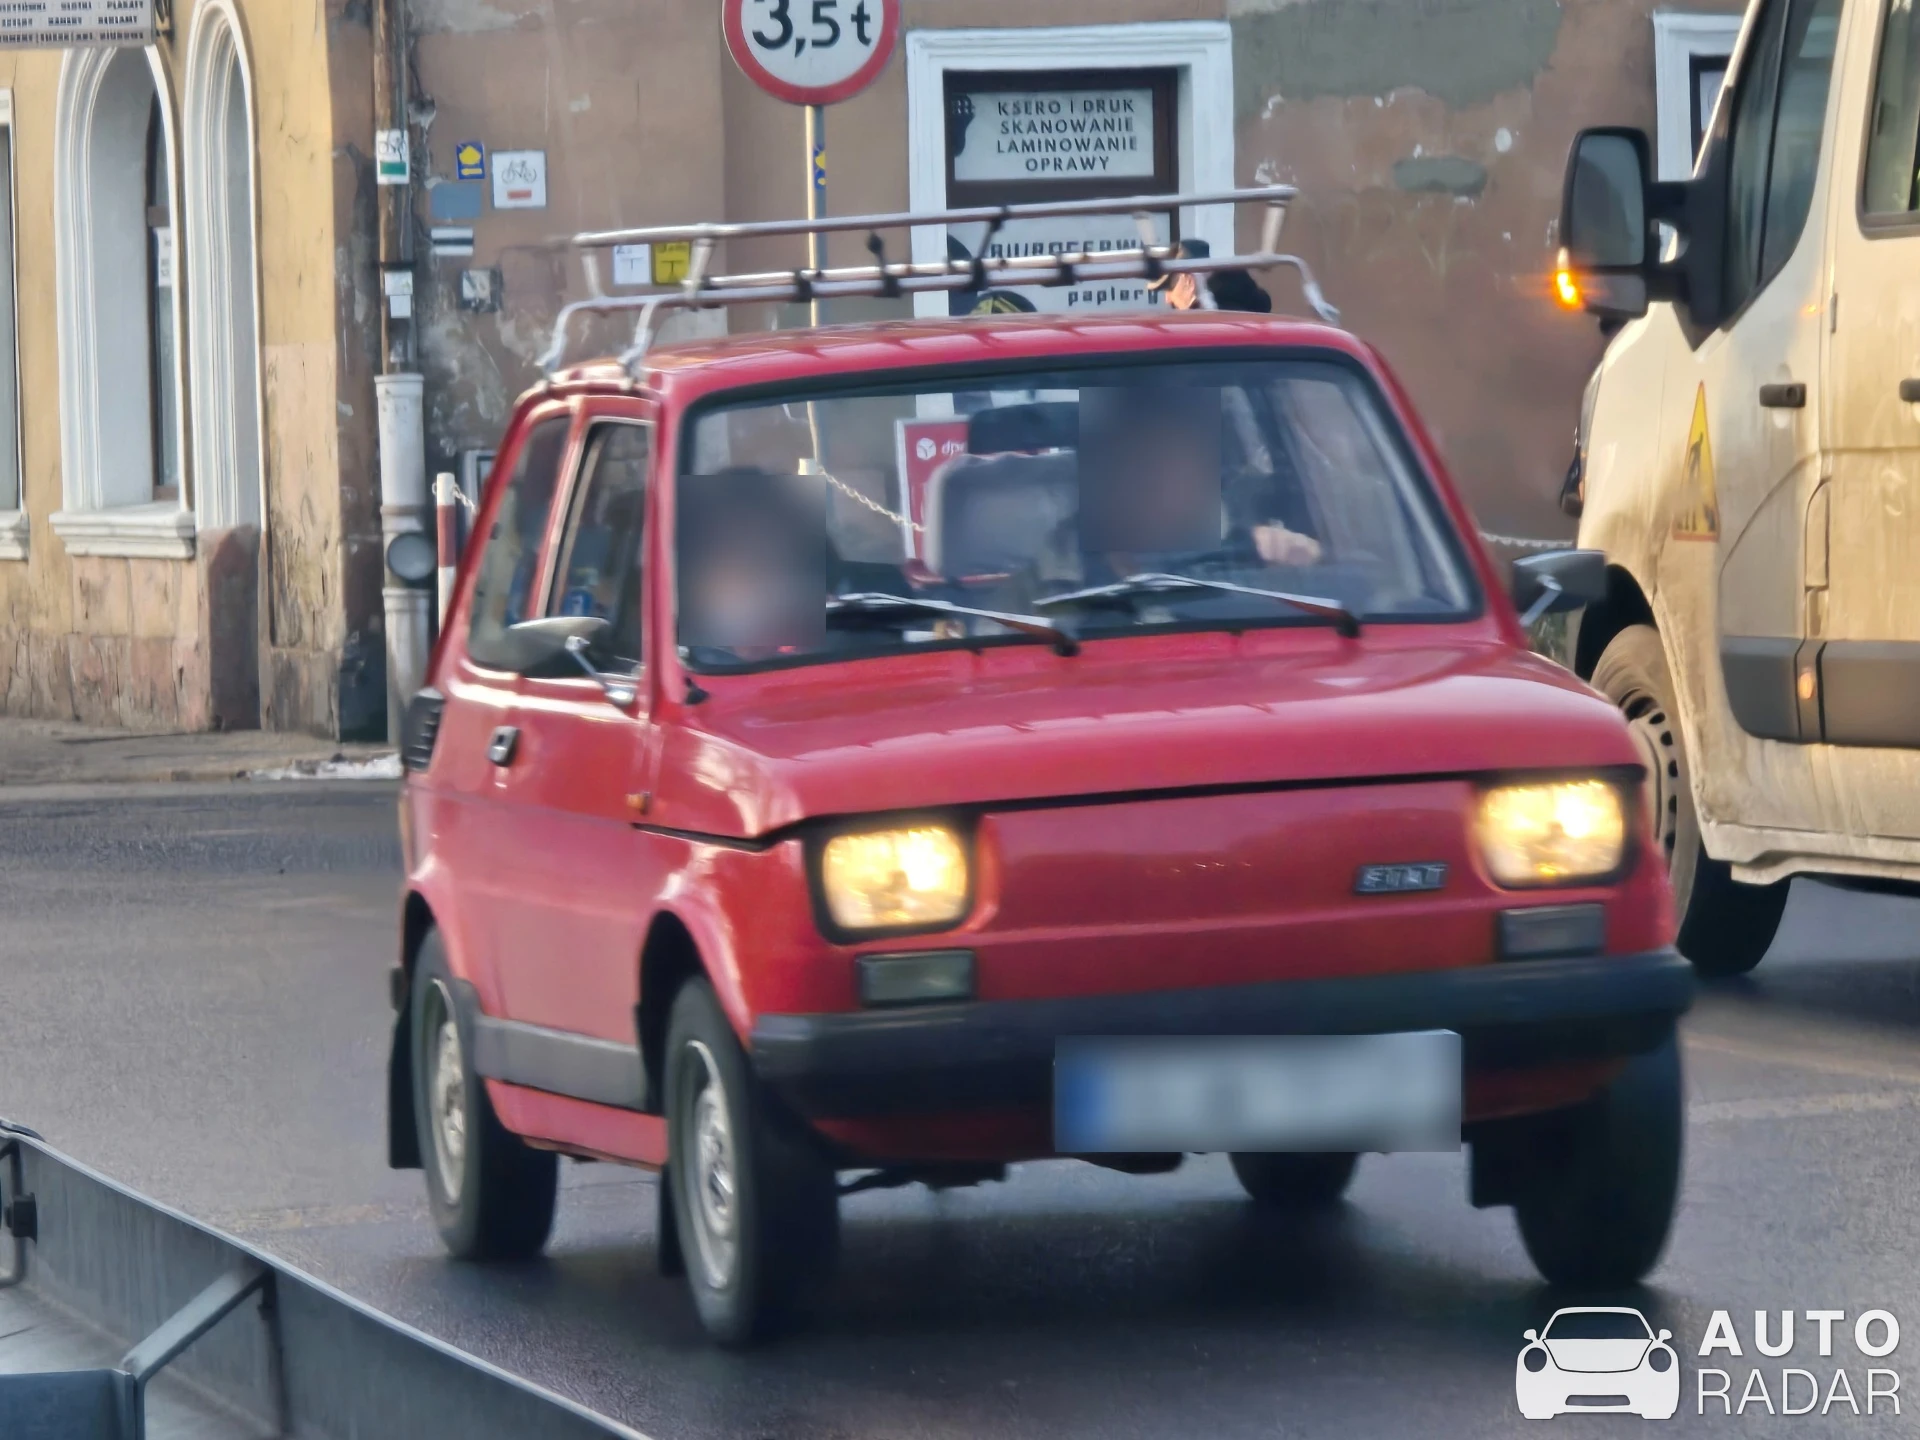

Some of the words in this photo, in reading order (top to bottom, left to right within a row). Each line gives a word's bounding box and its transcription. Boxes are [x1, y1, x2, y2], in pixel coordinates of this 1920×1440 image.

[752, 0, 841, 58] 3,5
[850, 0, 873, 47] t
[998, 101, 1061, 116] KSERO
[1083, 98, 1135, 113] DRUK
[1000, 116, 1134, 135] SKANOWANIE
[997, 136, 1137, 154] LAMINOWANIE
[1025, 155, 1110, 172] OPRAWY
[1067, 285, 1159, 306] papiery
[1360, 863, 1448, 889] FIAT
